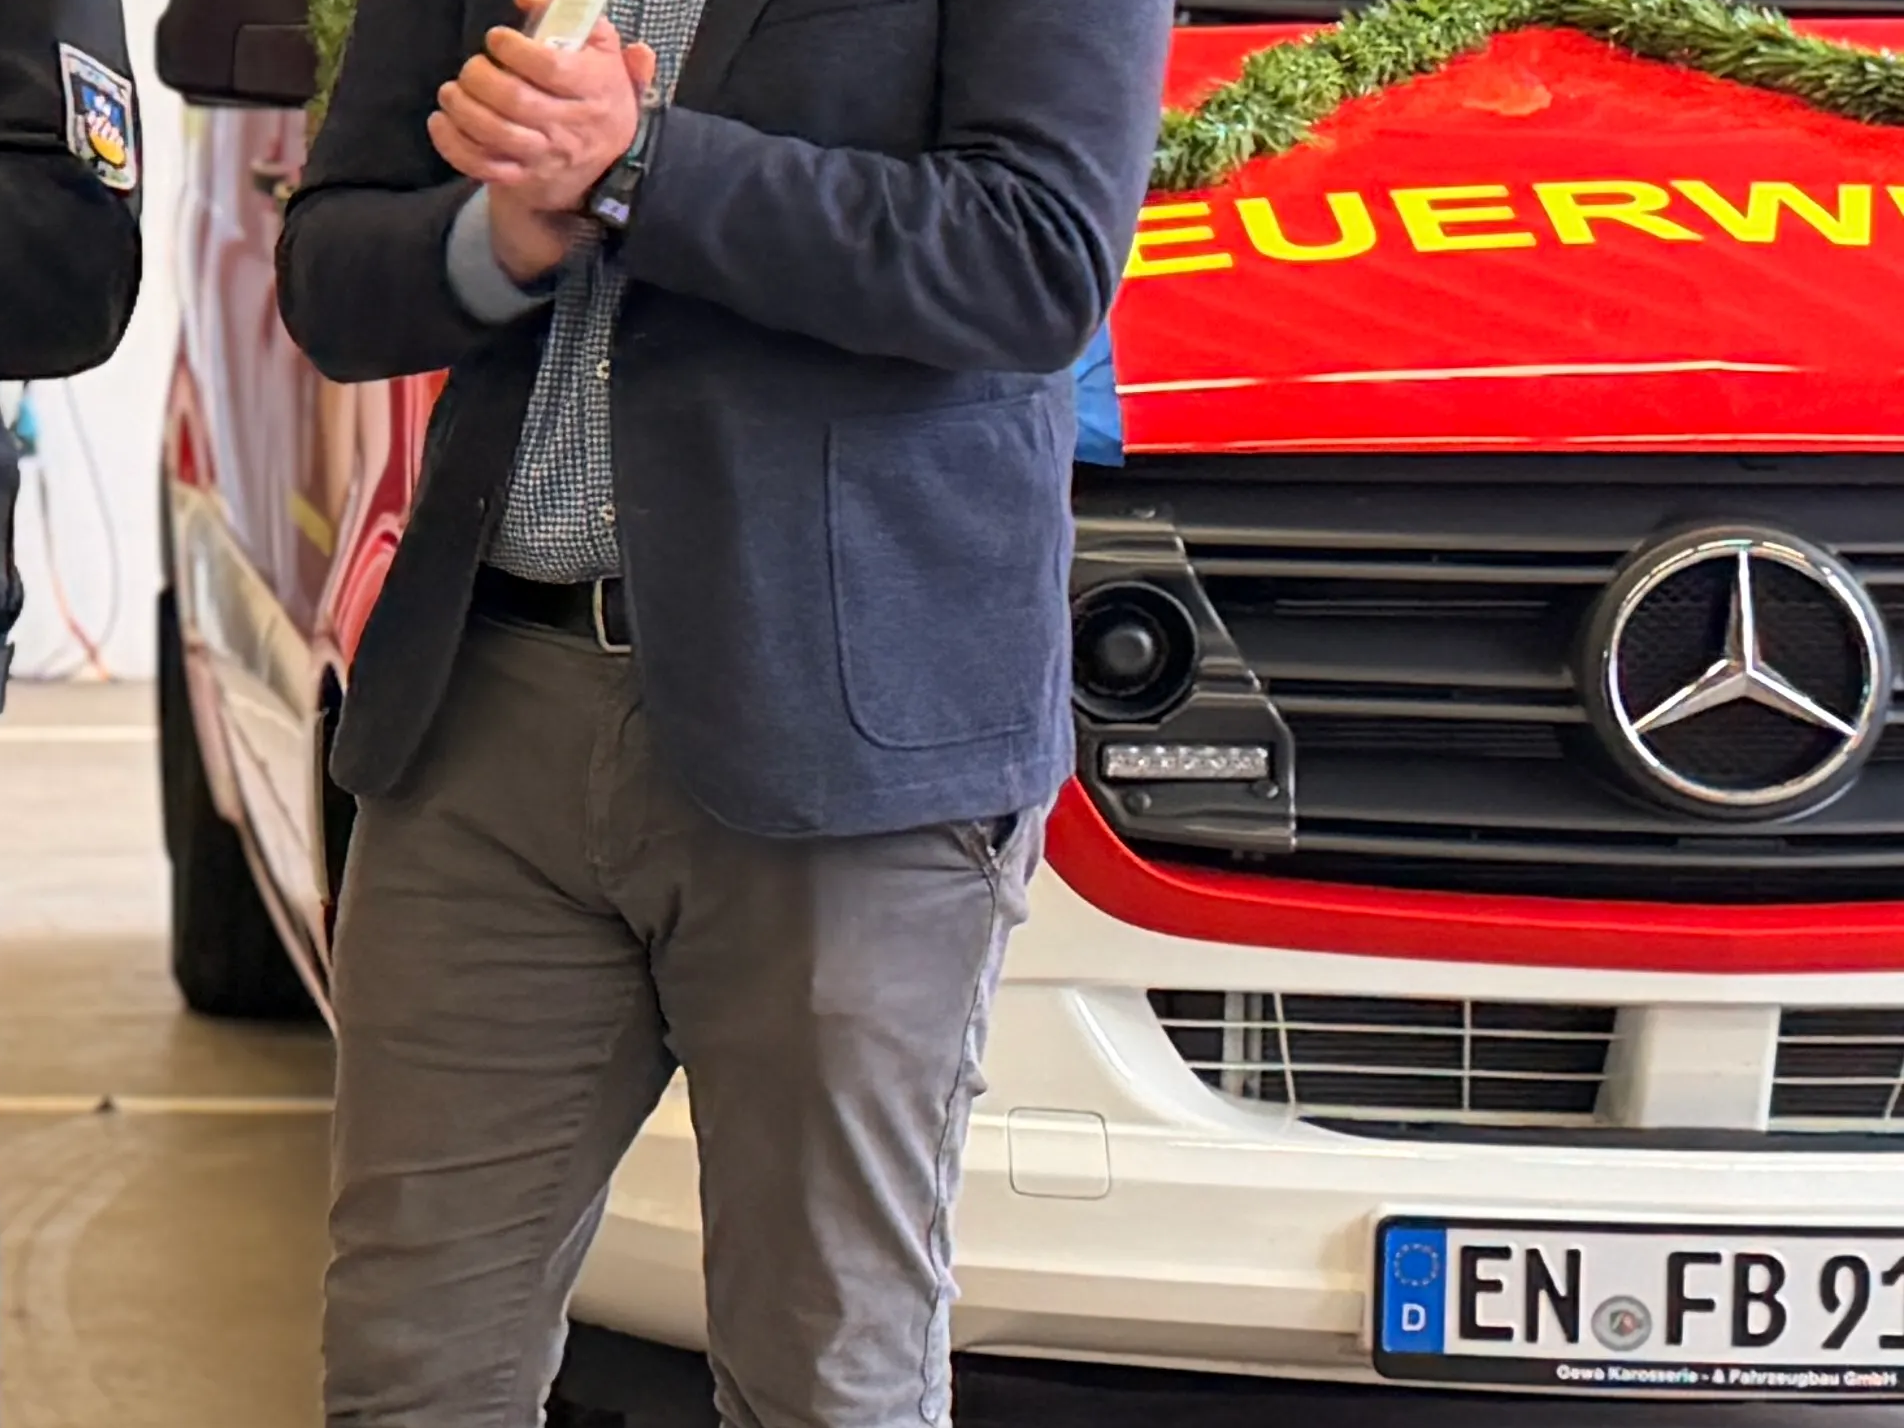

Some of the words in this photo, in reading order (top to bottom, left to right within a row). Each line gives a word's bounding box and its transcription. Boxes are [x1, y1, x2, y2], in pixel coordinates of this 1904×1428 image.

[1402, 1303, 1426, 1332] D
[1458, 1245, 1583, 1345] EN
[1665, 1251, 1788, 1349] FB
